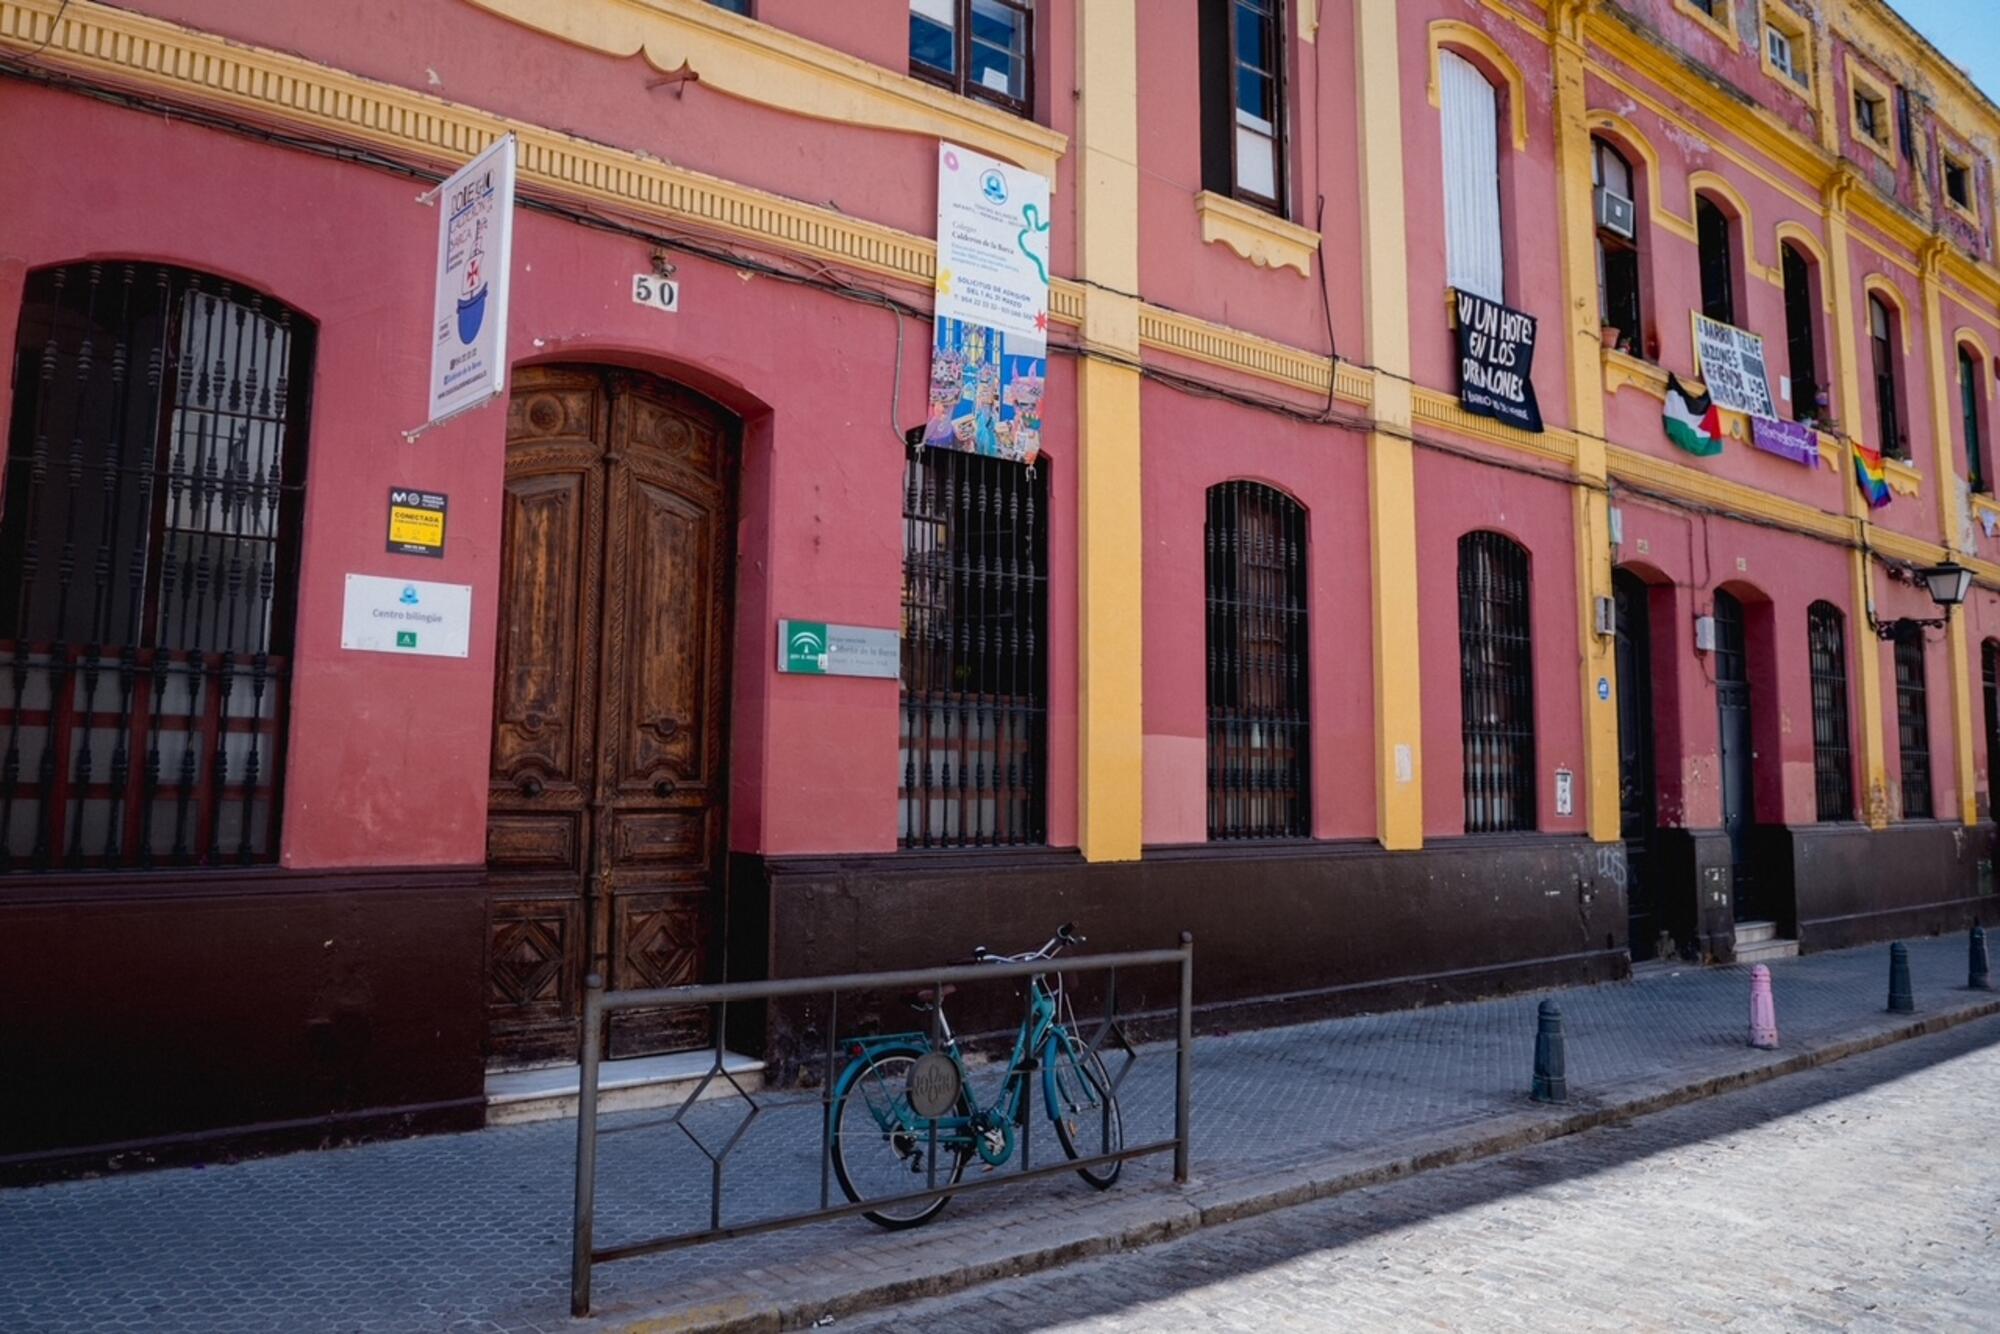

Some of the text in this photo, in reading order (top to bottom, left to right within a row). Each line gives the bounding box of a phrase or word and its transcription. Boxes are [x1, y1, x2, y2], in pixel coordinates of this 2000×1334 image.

[998, 242, 1015, 255] Barca
[957, 276, 992, 291] SOLICITUD
[993, 284, 1001, 294] DE
[966, 286, 979, 297] DEL
[1002, 297, 1023, 309] MARZO
[1474, 298, 1499, 338] UN
[1469, 331, 1516, 368] EN LOS
[394, 511, 440, 523] CONECTADA
[372, 608, 443, 624] Centro bilingüe
